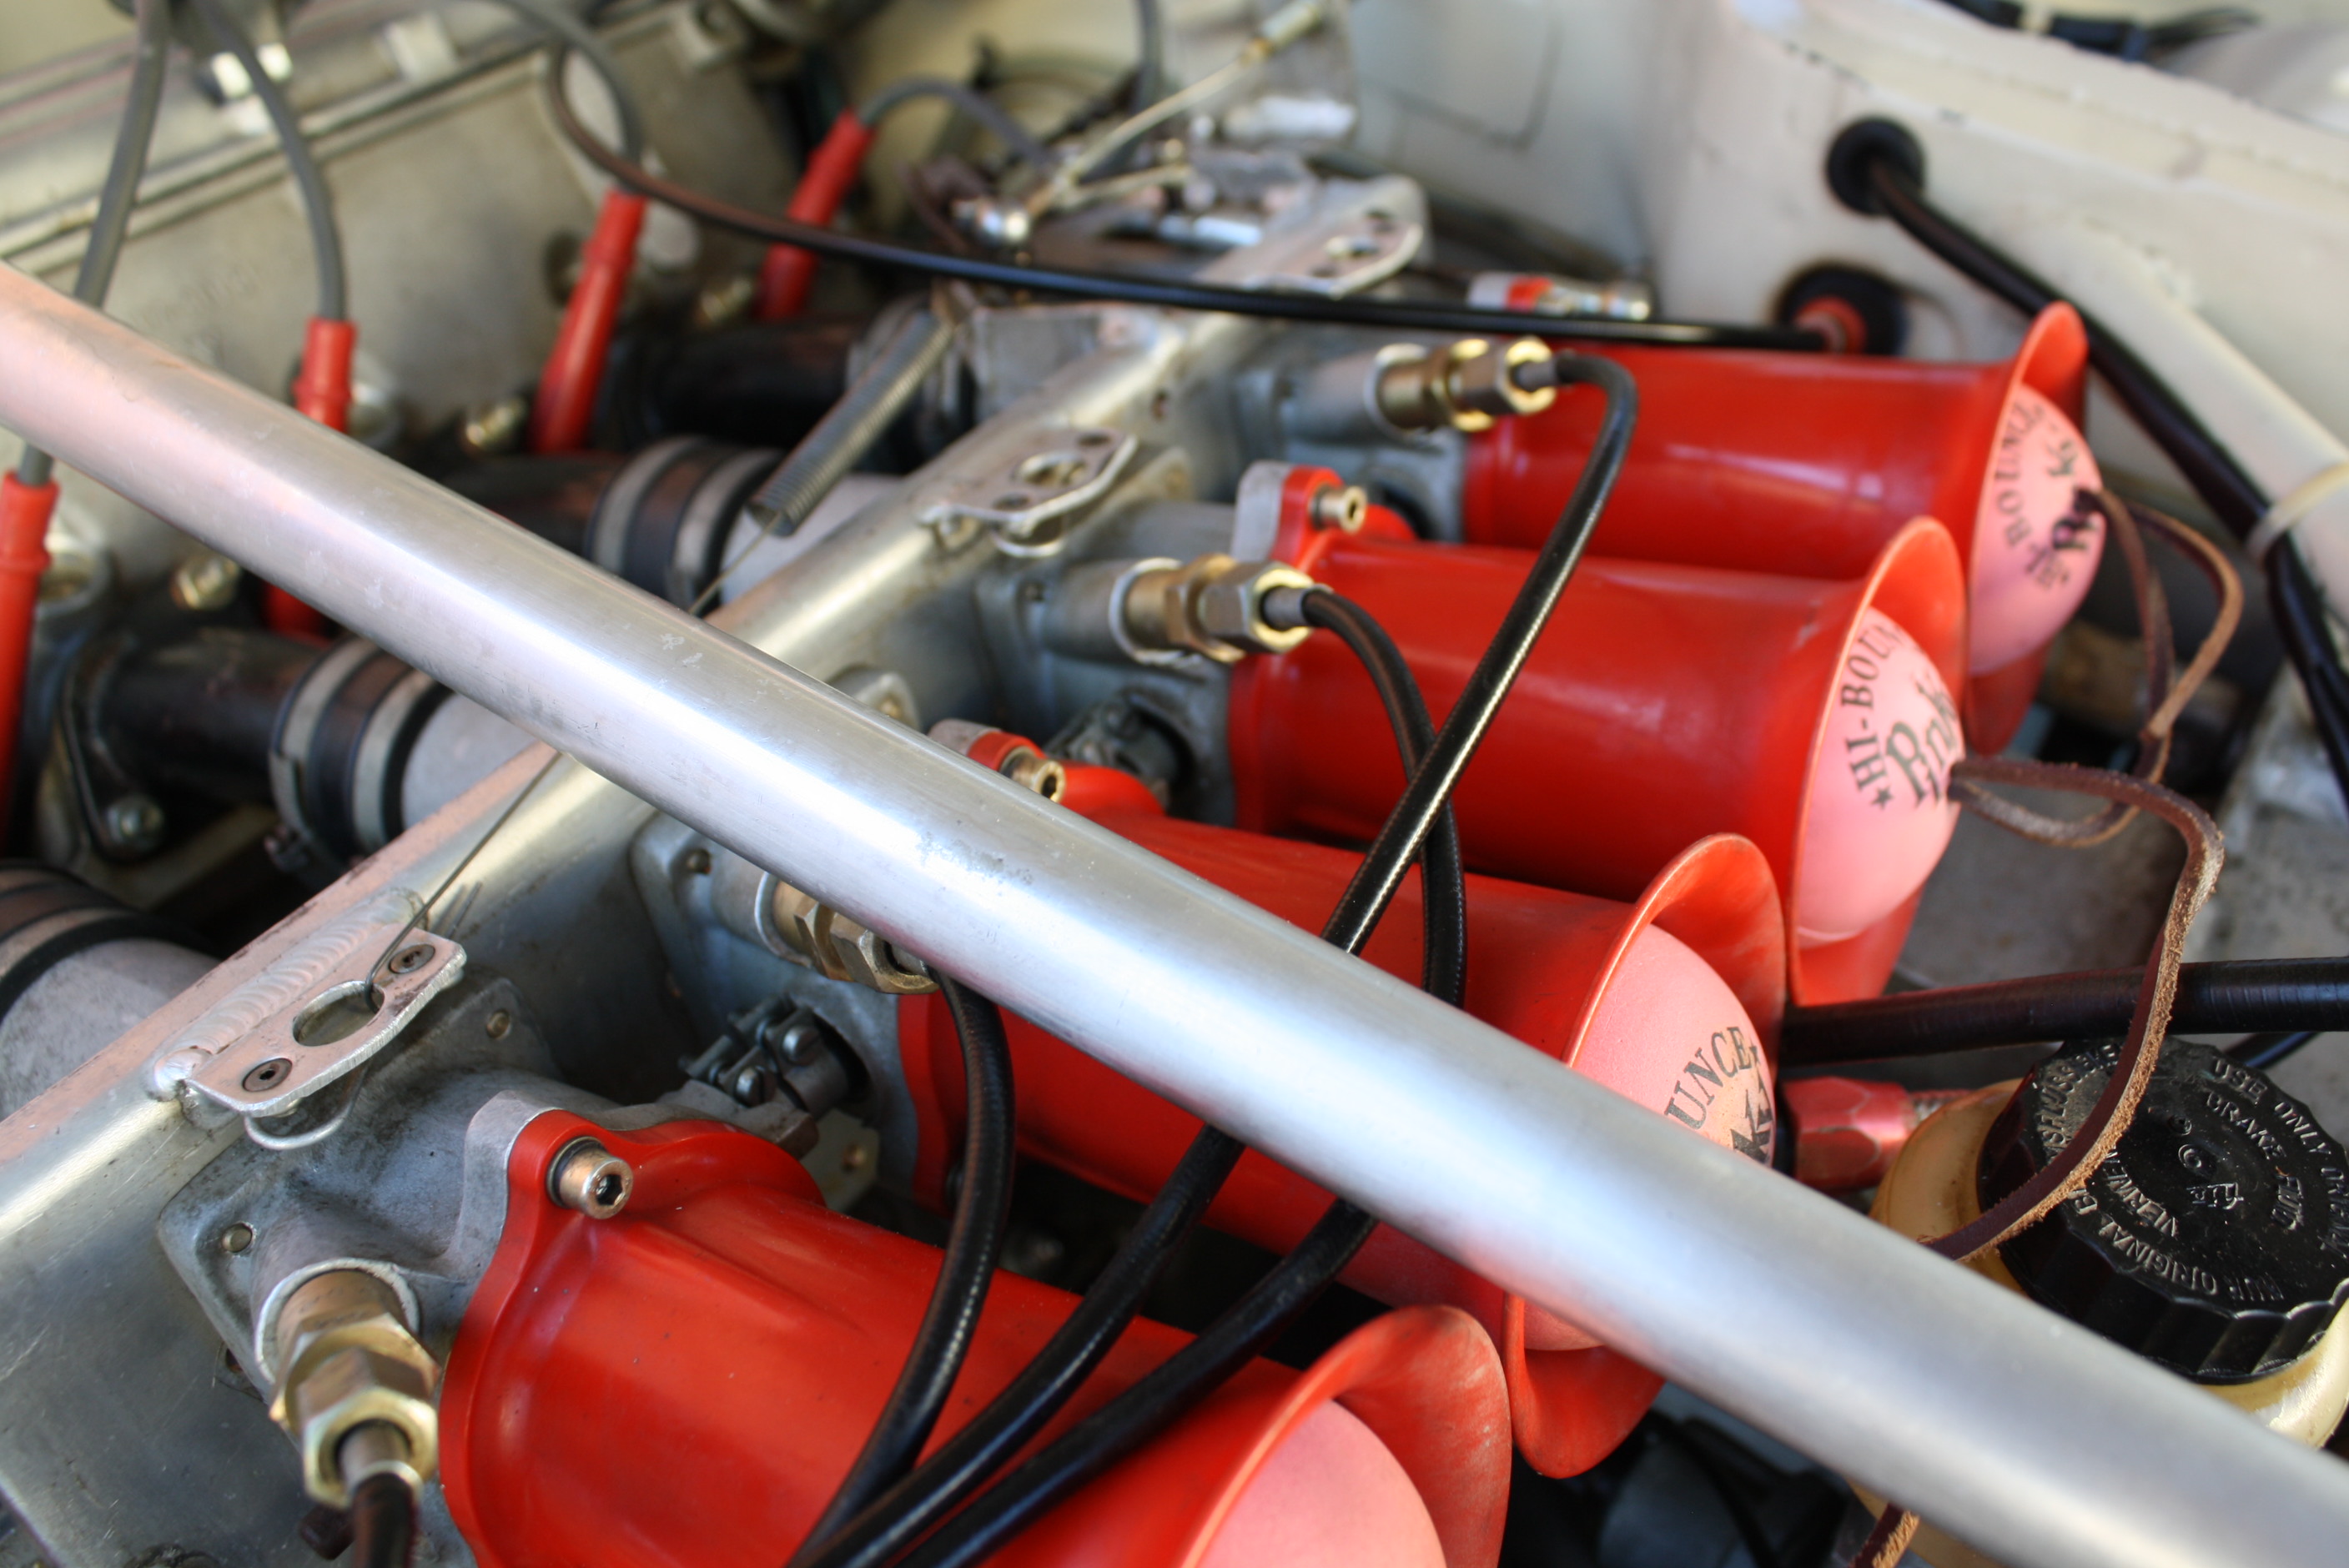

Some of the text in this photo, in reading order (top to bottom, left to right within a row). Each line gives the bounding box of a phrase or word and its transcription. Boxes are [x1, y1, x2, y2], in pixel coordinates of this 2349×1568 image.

[1664, 1027, 1753, 1129] UNCE
[2213, 1058, 2268, 1105] USE
[2274, 1102, 2332, 1155] ONLY
[2206, 1091, 2287, 1160] BRAKE
[2101, 1150, 2179, 1238] VERWEN
[2098, 1214, 2218, 1295] ORIGINAL
